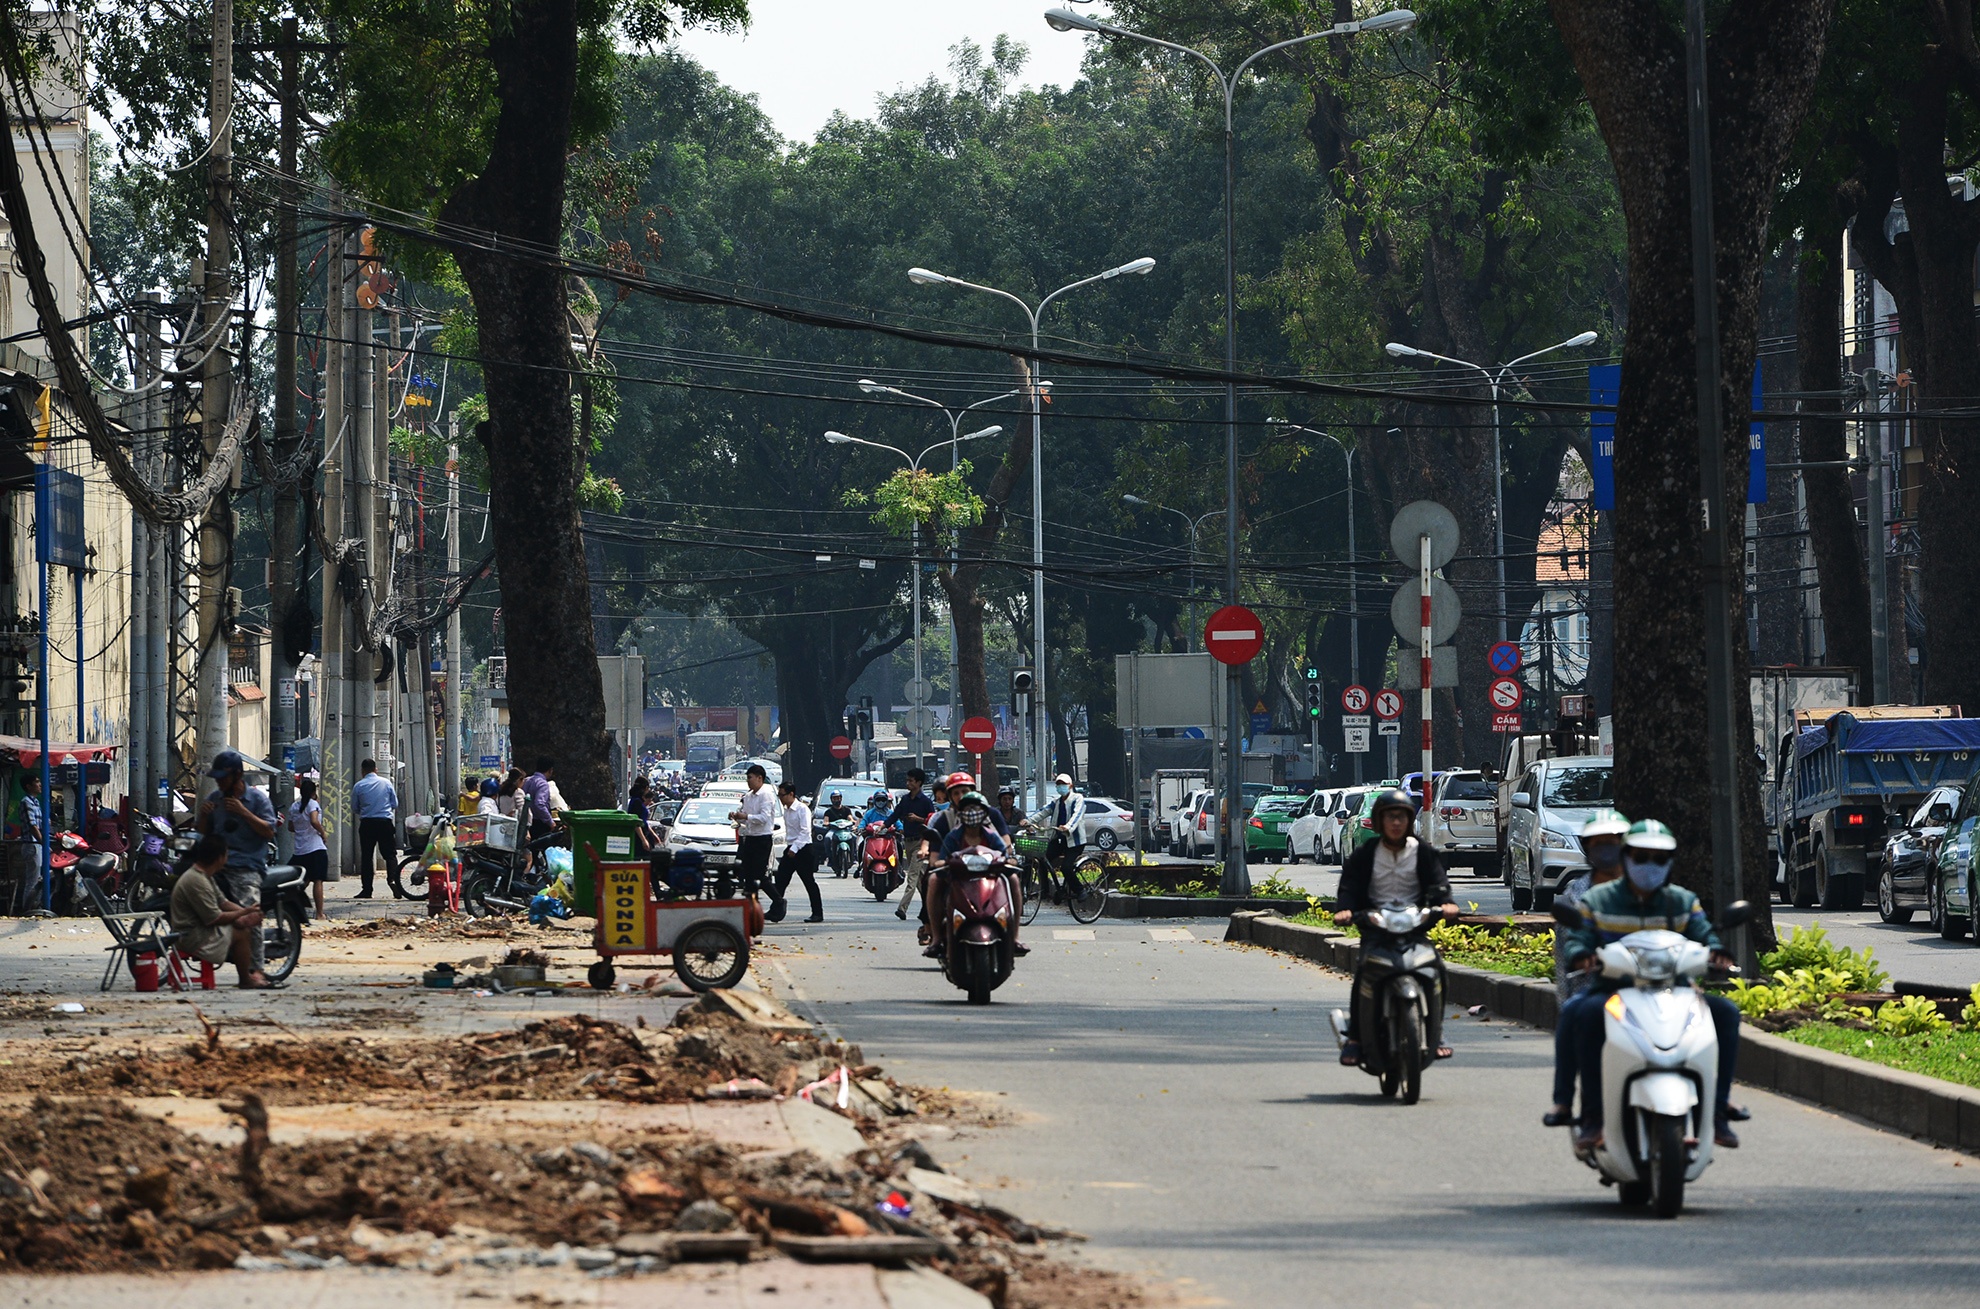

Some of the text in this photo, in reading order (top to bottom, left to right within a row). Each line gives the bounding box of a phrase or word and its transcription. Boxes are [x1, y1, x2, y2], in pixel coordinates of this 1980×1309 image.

[1307, 668, 1317, 679] 23
[1496, 713, 1518, 724] CẤM
[616, 885, 634, 944] HONDA
